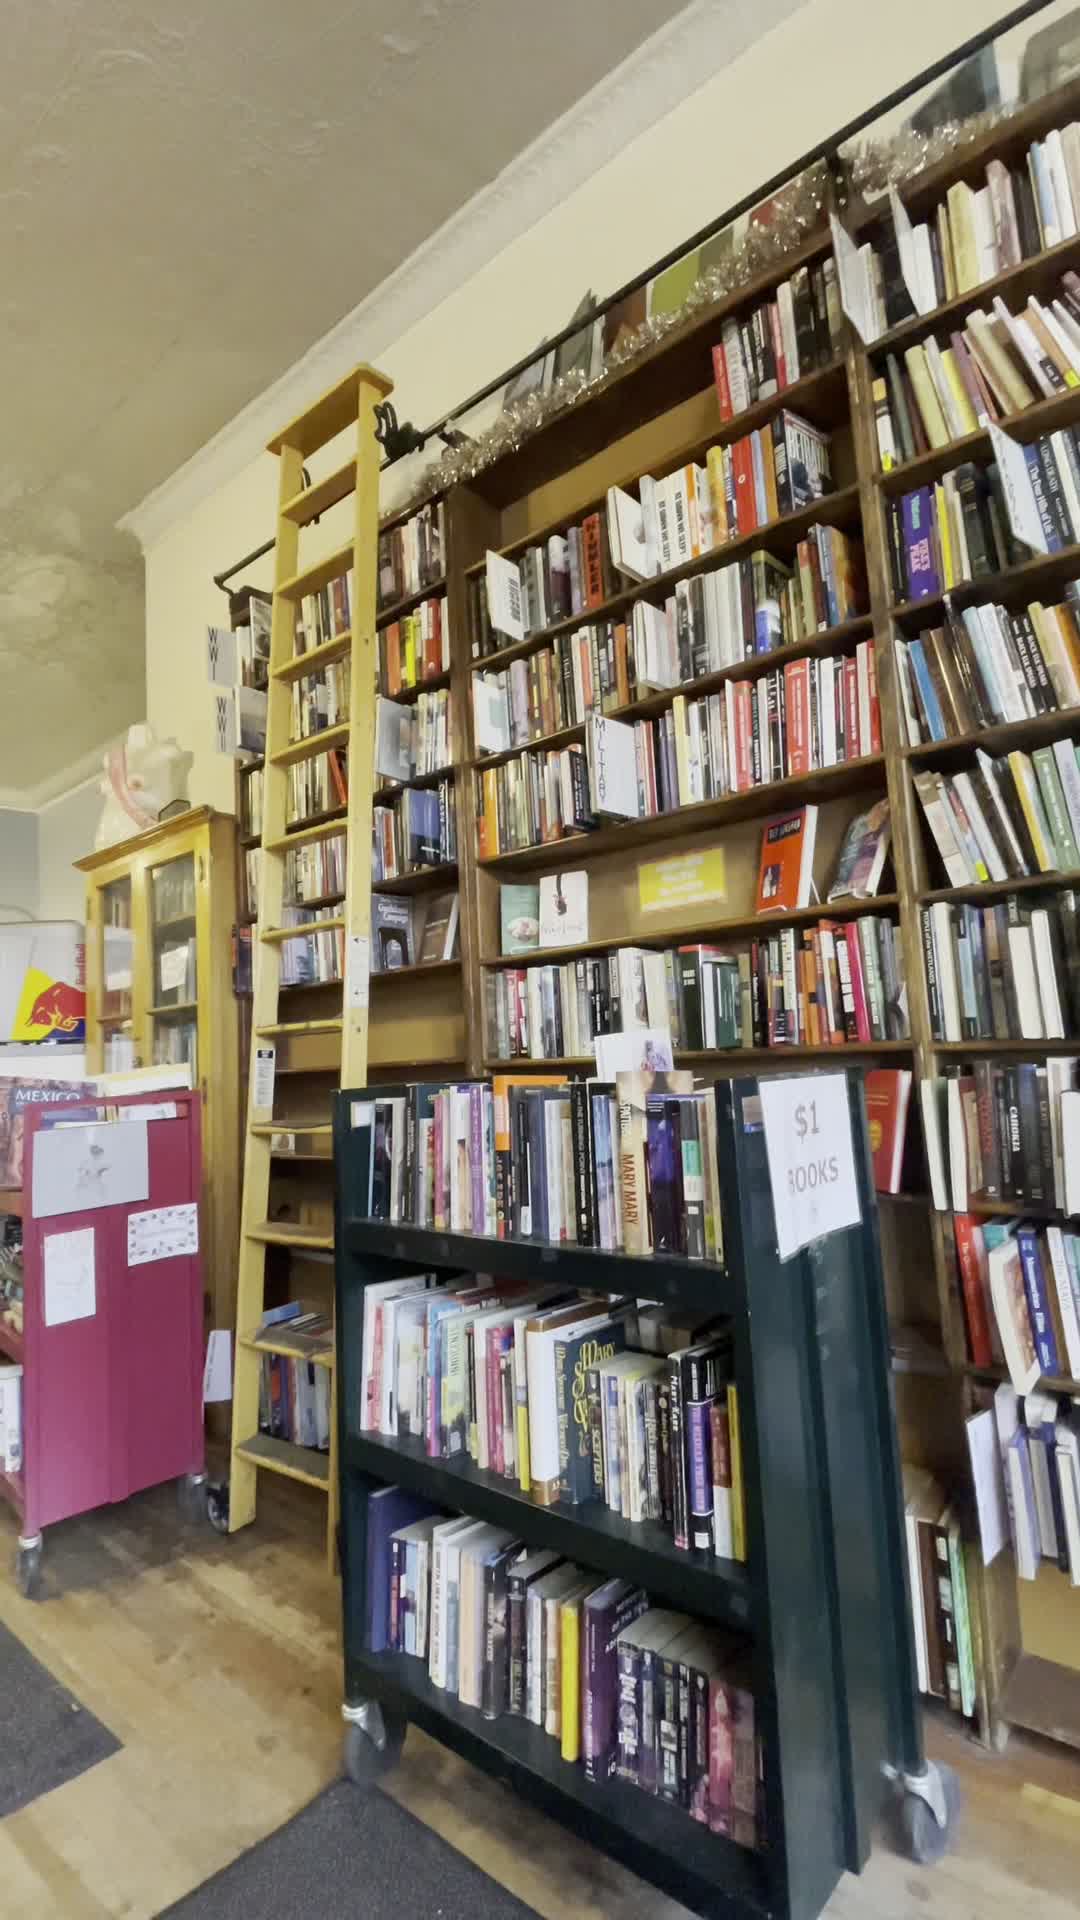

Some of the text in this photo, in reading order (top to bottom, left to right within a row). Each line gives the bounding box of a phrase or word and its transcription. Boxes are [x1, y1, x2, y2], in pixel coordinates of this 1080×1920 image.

[926, 949, 935, 984] WETLANDS
[15, 1088, 80, 1102] MEXICO
[795, 1099, 821, 1145] $1
[1009, 1106, 1021, 1152] CAHOKIA
[621, 1153, 636, 1188] MARY
[624, 1188, 640, 1225] MARY
[670, 1375, 679, 1403] MARY
